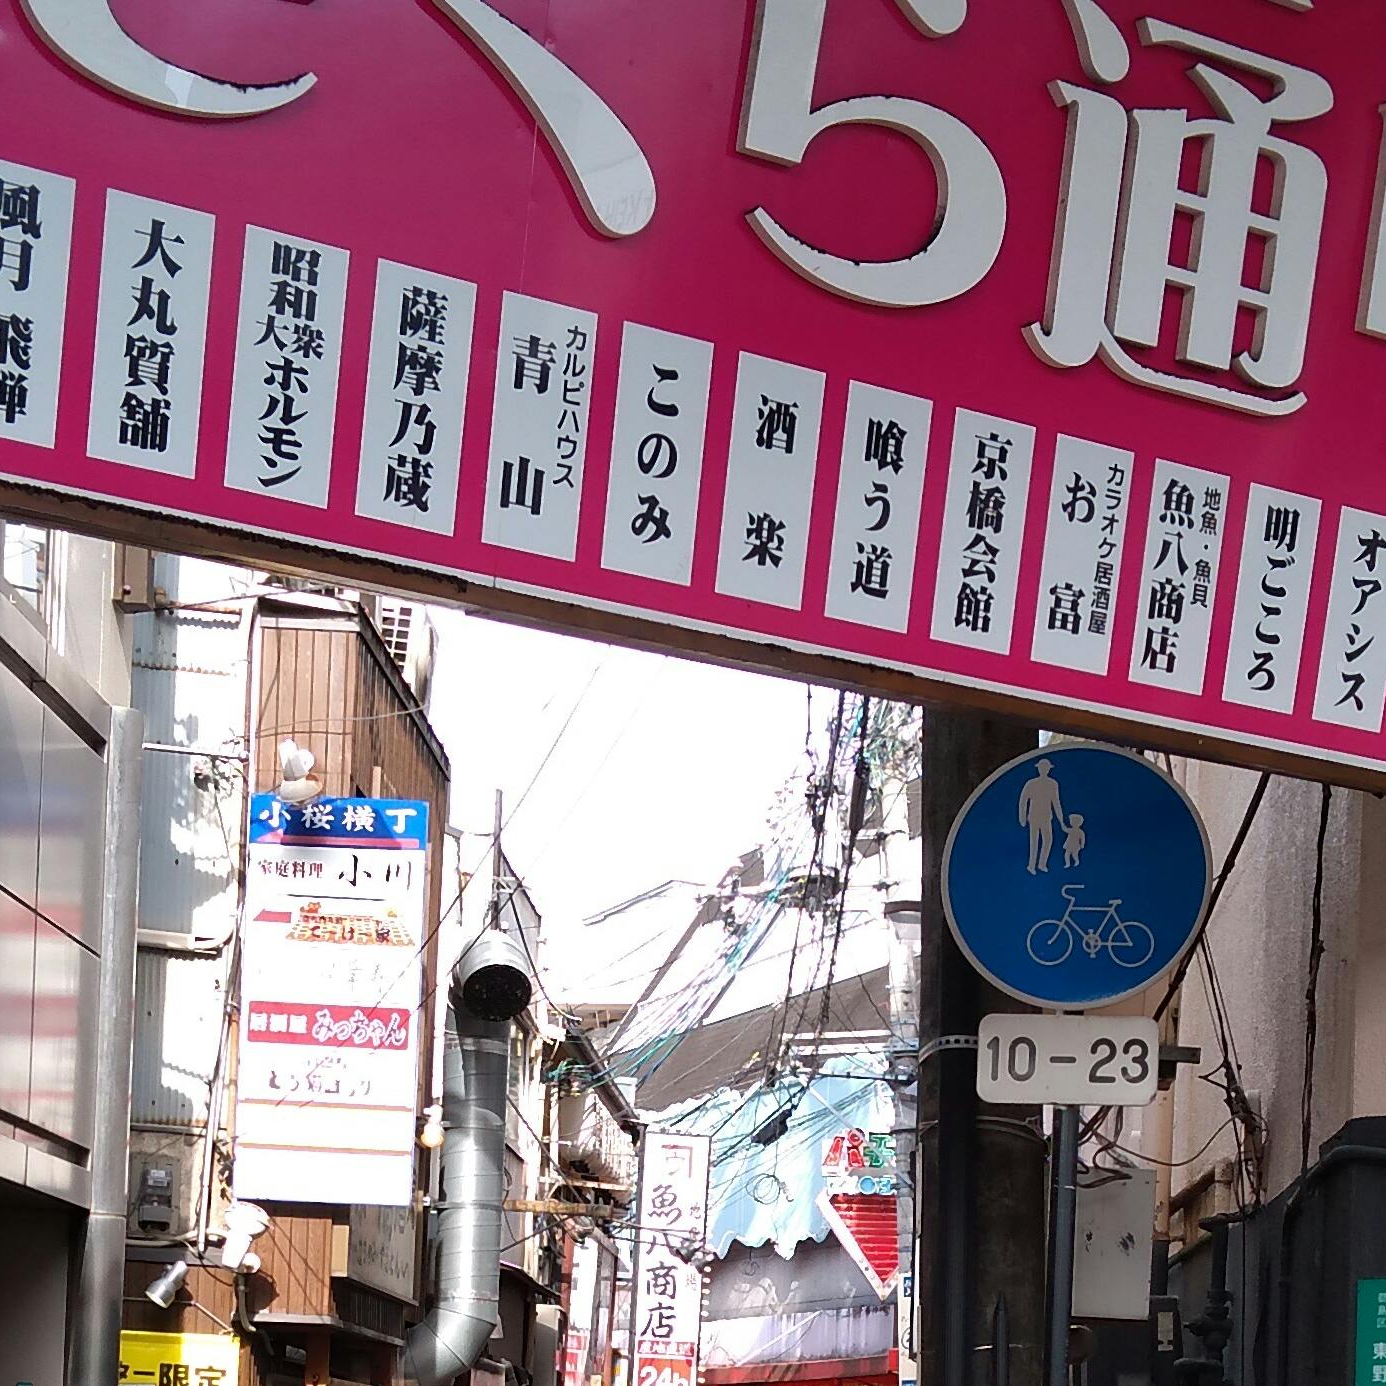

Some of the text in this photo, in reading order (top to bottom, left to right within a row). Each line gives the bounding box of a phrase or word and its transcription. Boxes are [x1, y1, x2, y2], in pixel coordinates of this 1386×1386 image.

[119, 219, 184, 452] 大丸質舗
[383, 286, 447, 512] 薩摩乃蔵
[552, 325, 587, 489] カルビハウス
[630, 363, 679, 543] このみ
[850, 418, 907, 599] 喰う道
[954, 433, 1013, 633] 京橋会館
[1086, 464, 1129, 635] カラオケ居酒屋
[1139, 478, 1197, 673] 魚八商店
[1248, 505, 1308, 690] 明ごころ
[259, 804, 418, 834] 小桜横丁
[986, 1035, 1150, 1084] 10-23
